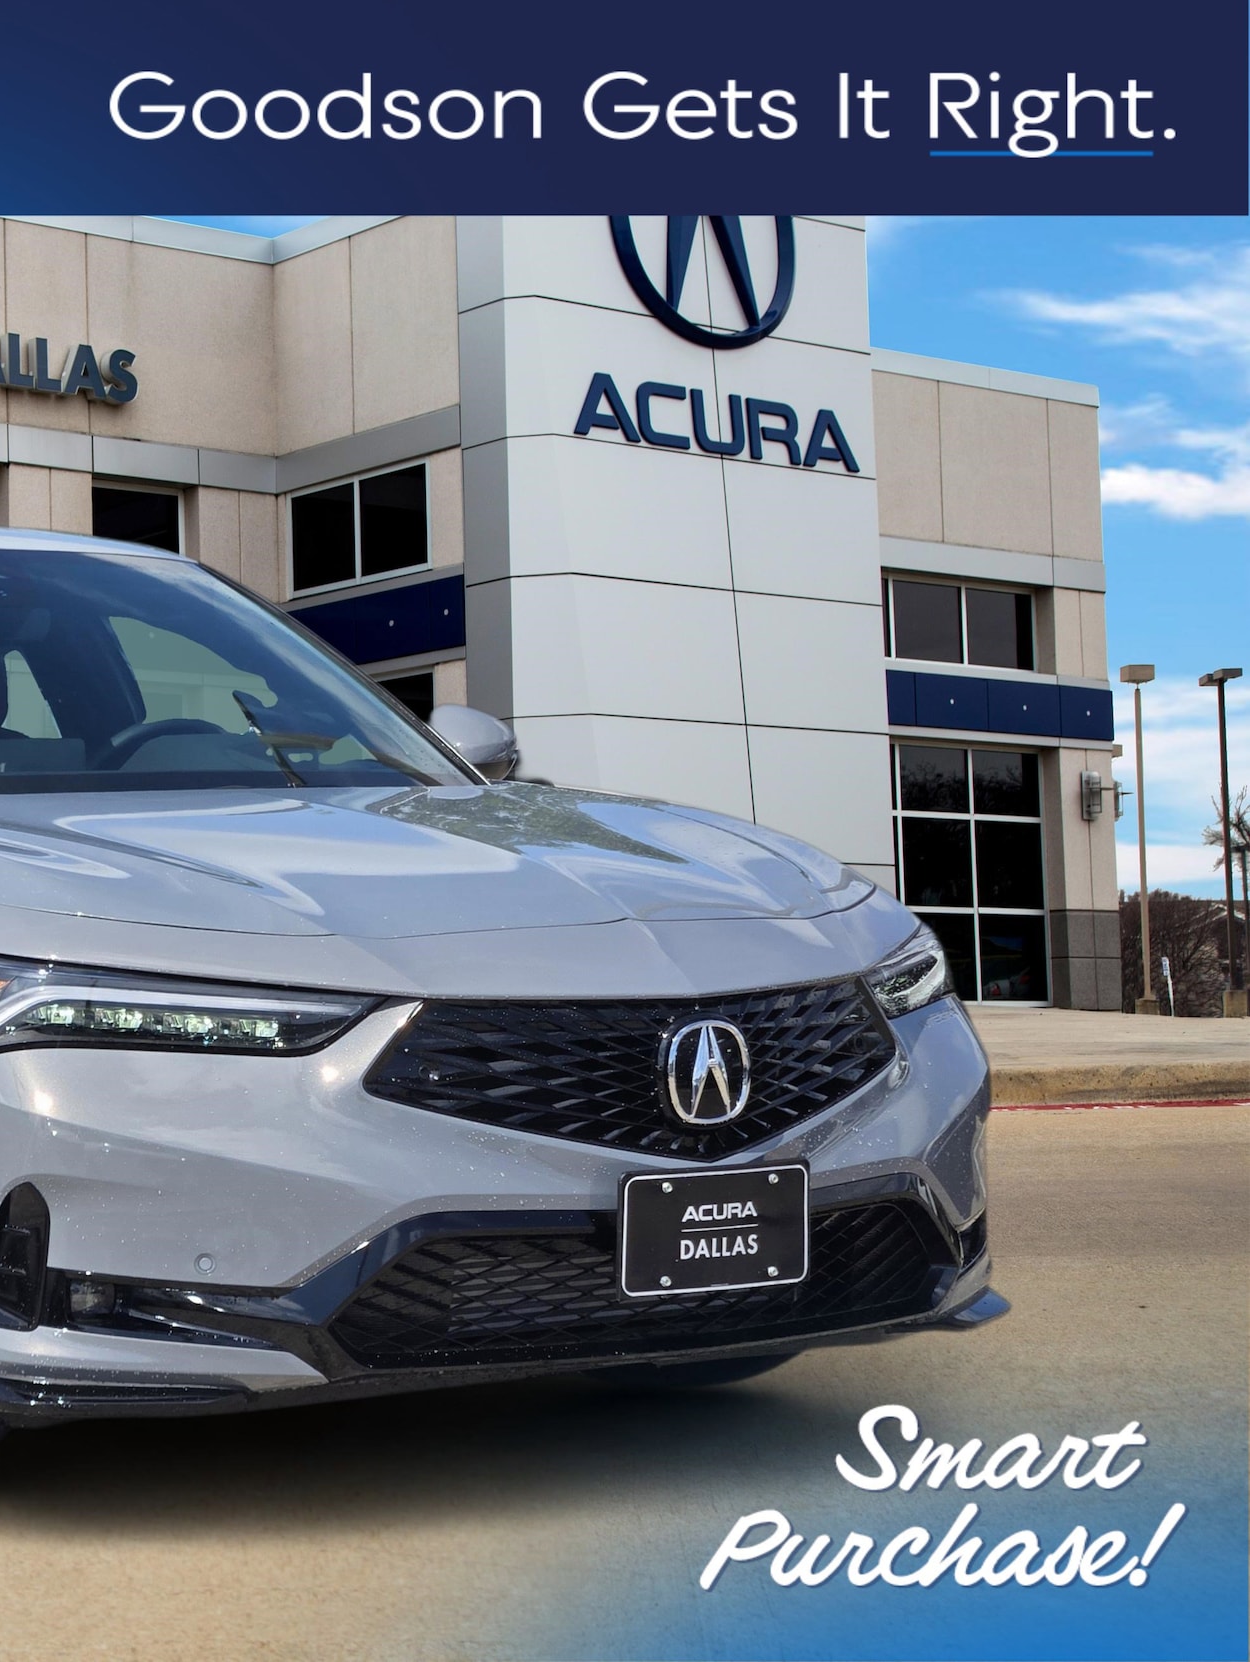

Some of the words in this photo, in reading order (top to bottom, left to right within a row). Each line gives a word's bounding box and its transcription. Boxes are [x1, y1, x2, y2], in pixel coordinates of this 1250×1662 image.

[573, 372, 860, 474] ACURA
[681, 1201, 758, 1223] ACURA
[680, 1234, 759, 1260] DALLAS
